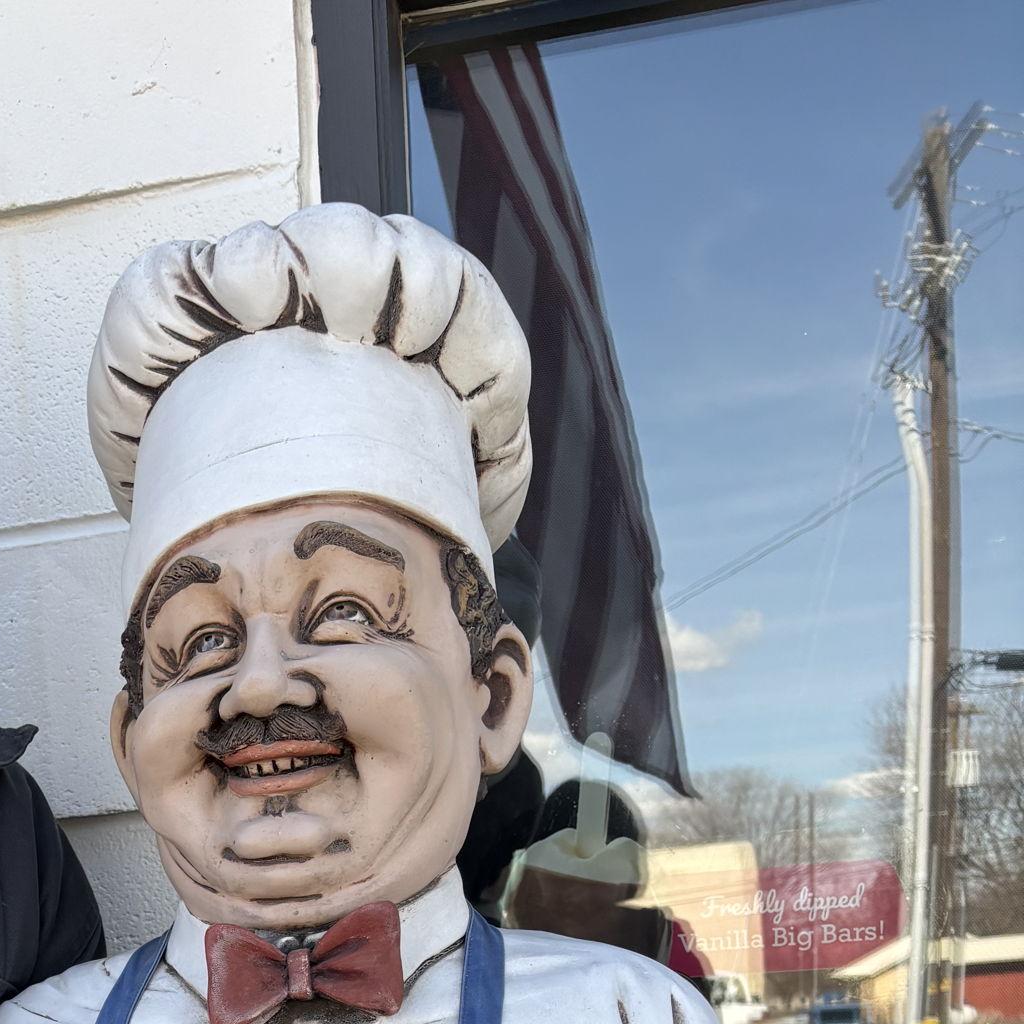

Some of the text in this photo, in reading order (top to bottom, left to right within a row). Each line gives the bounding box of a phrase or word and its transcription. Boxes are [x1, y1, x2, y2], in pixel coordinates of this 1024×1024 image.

[700, 882, 865, 924] Freshly dipped
[678, 920, 885, 953] Vanilla Big Bars!
